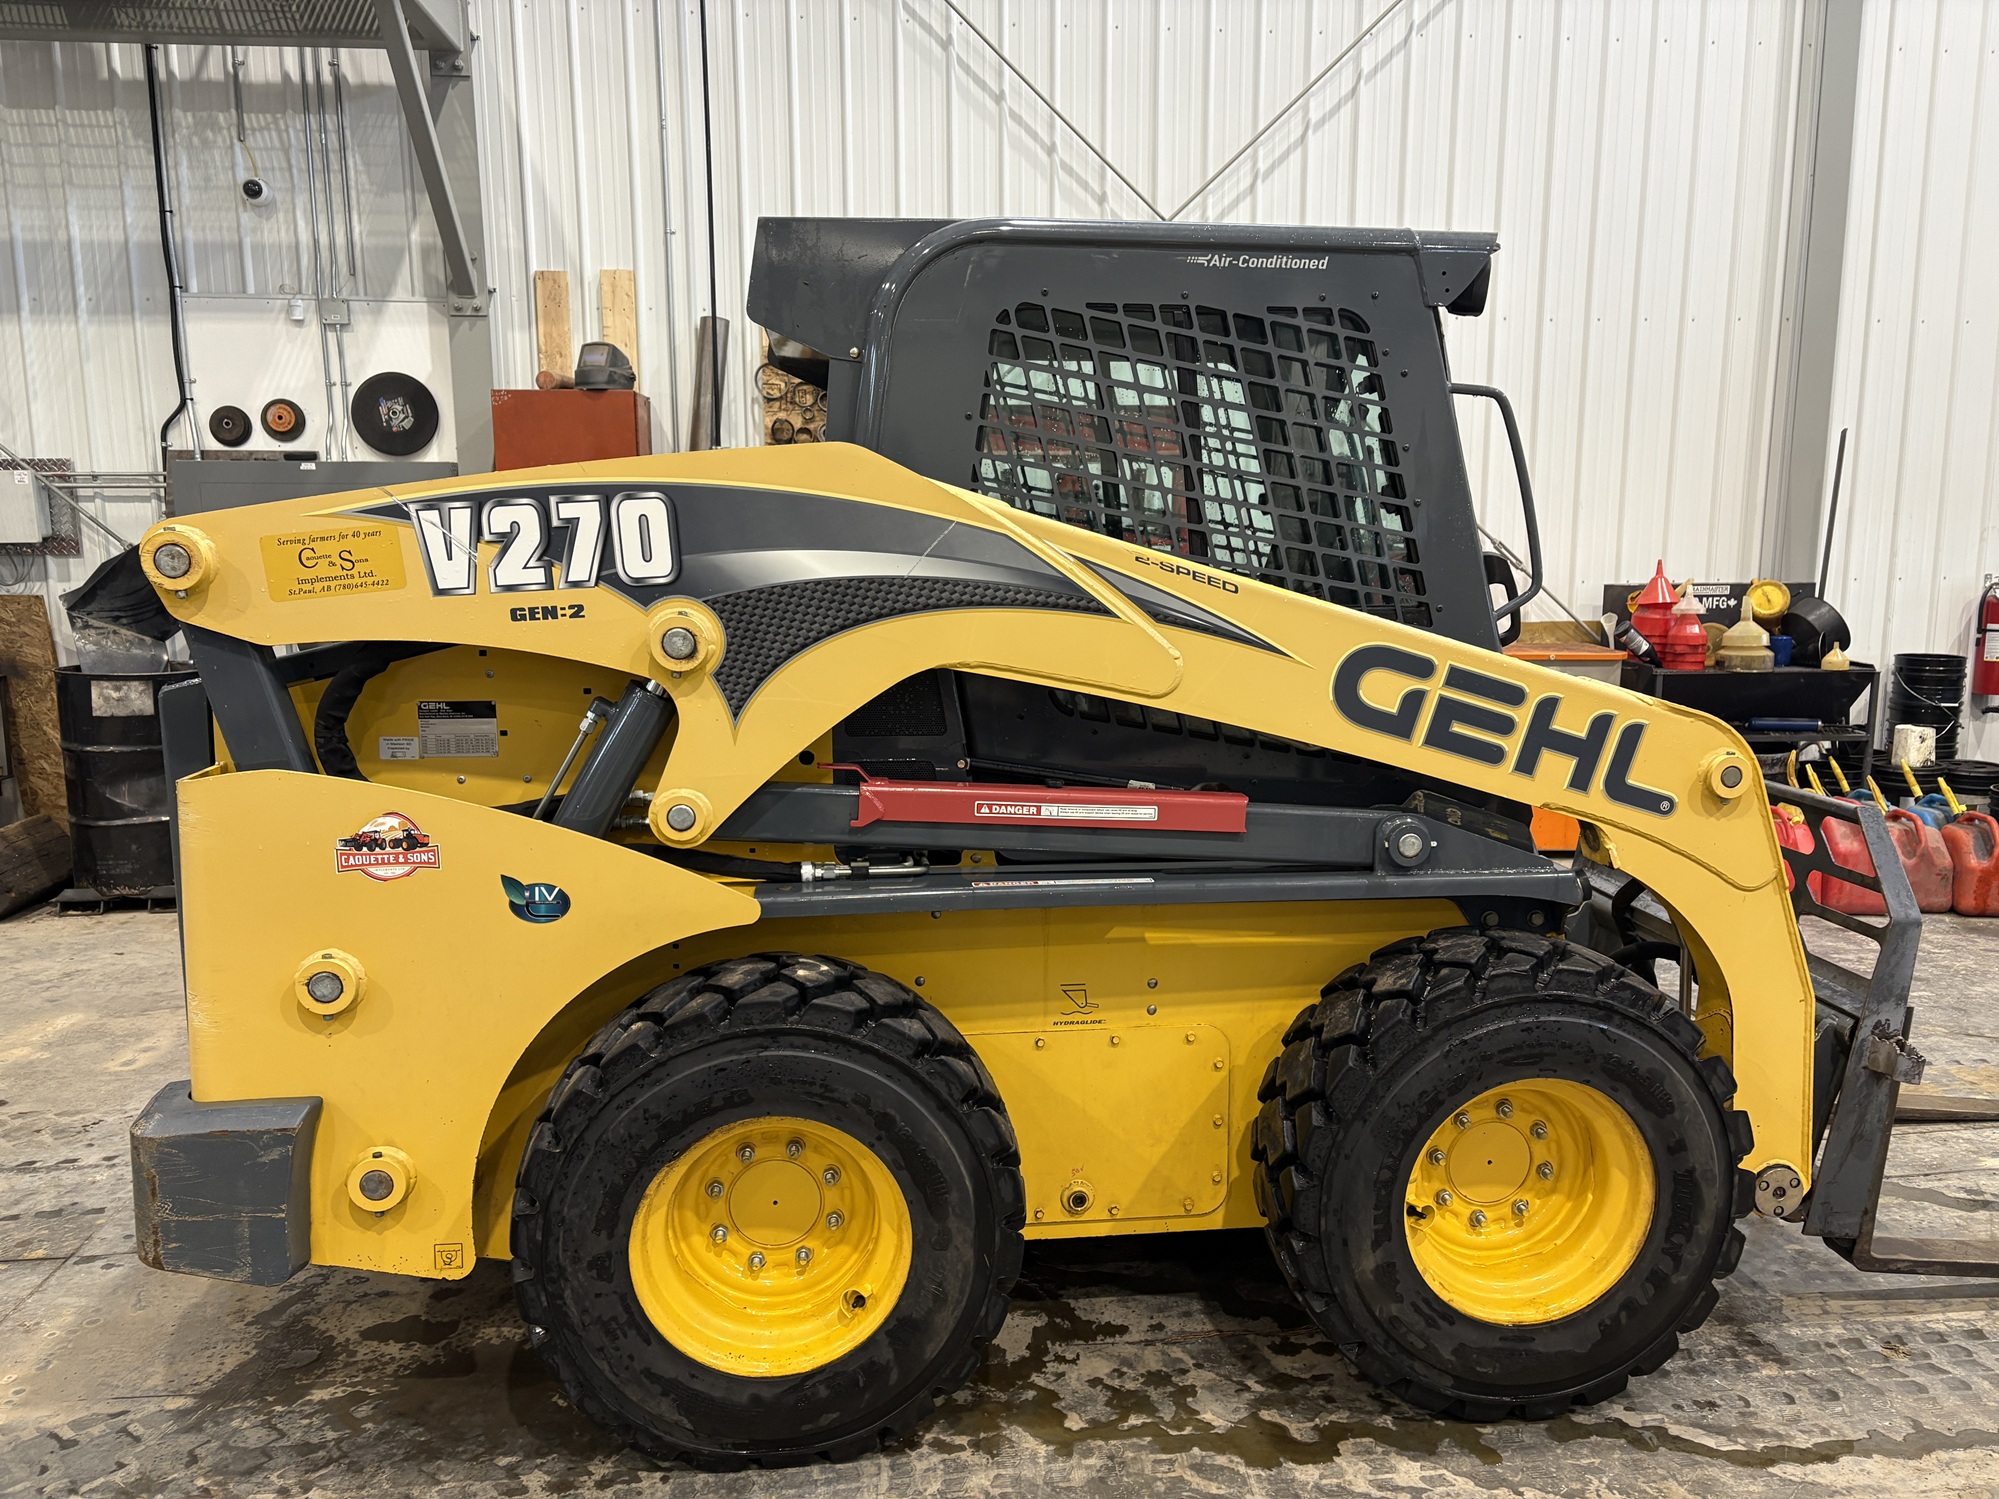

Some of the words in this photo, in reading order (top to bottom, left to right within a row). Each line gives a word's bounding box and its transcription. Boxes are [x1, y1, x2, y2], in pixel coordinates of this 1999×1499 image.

[1209, 254, 1329, 270] Air-Conditioned
[277, 537, 306, 547] Serving
[307, 534, 336, 545] farmers
[337, 531, 349, 542] for
[351, 530, 361, 538] 40
[362, 529, 382, 540] years
[407, 491, 681, 597] V270
[298, 547, 332, 569] Caouette
[338, 549, 369, 571] Sons
[297, 573, 355, 586] Implements
[357, 570, 377, 579] Ltd.
[1135, 555, 1239, 594] 2-SPEED
[288, 587, 317, 596] St.Paul,
[319, 585, 332, 593] AB
[334, 579, 390, 593] (780)645-4422
[1702, 596, 1728, 609] MFG
[510, 604, 586, 622] GEN:2
[420, 702, 451, 710] GEHL
[992, 805, 1038, 815] DANGER
[341, 854, 396, 866] CAOUETTE
[398, 853, 405, 863] &
[407, 852, 435, 863] SONS
[534, 886, 560, 901] IV
